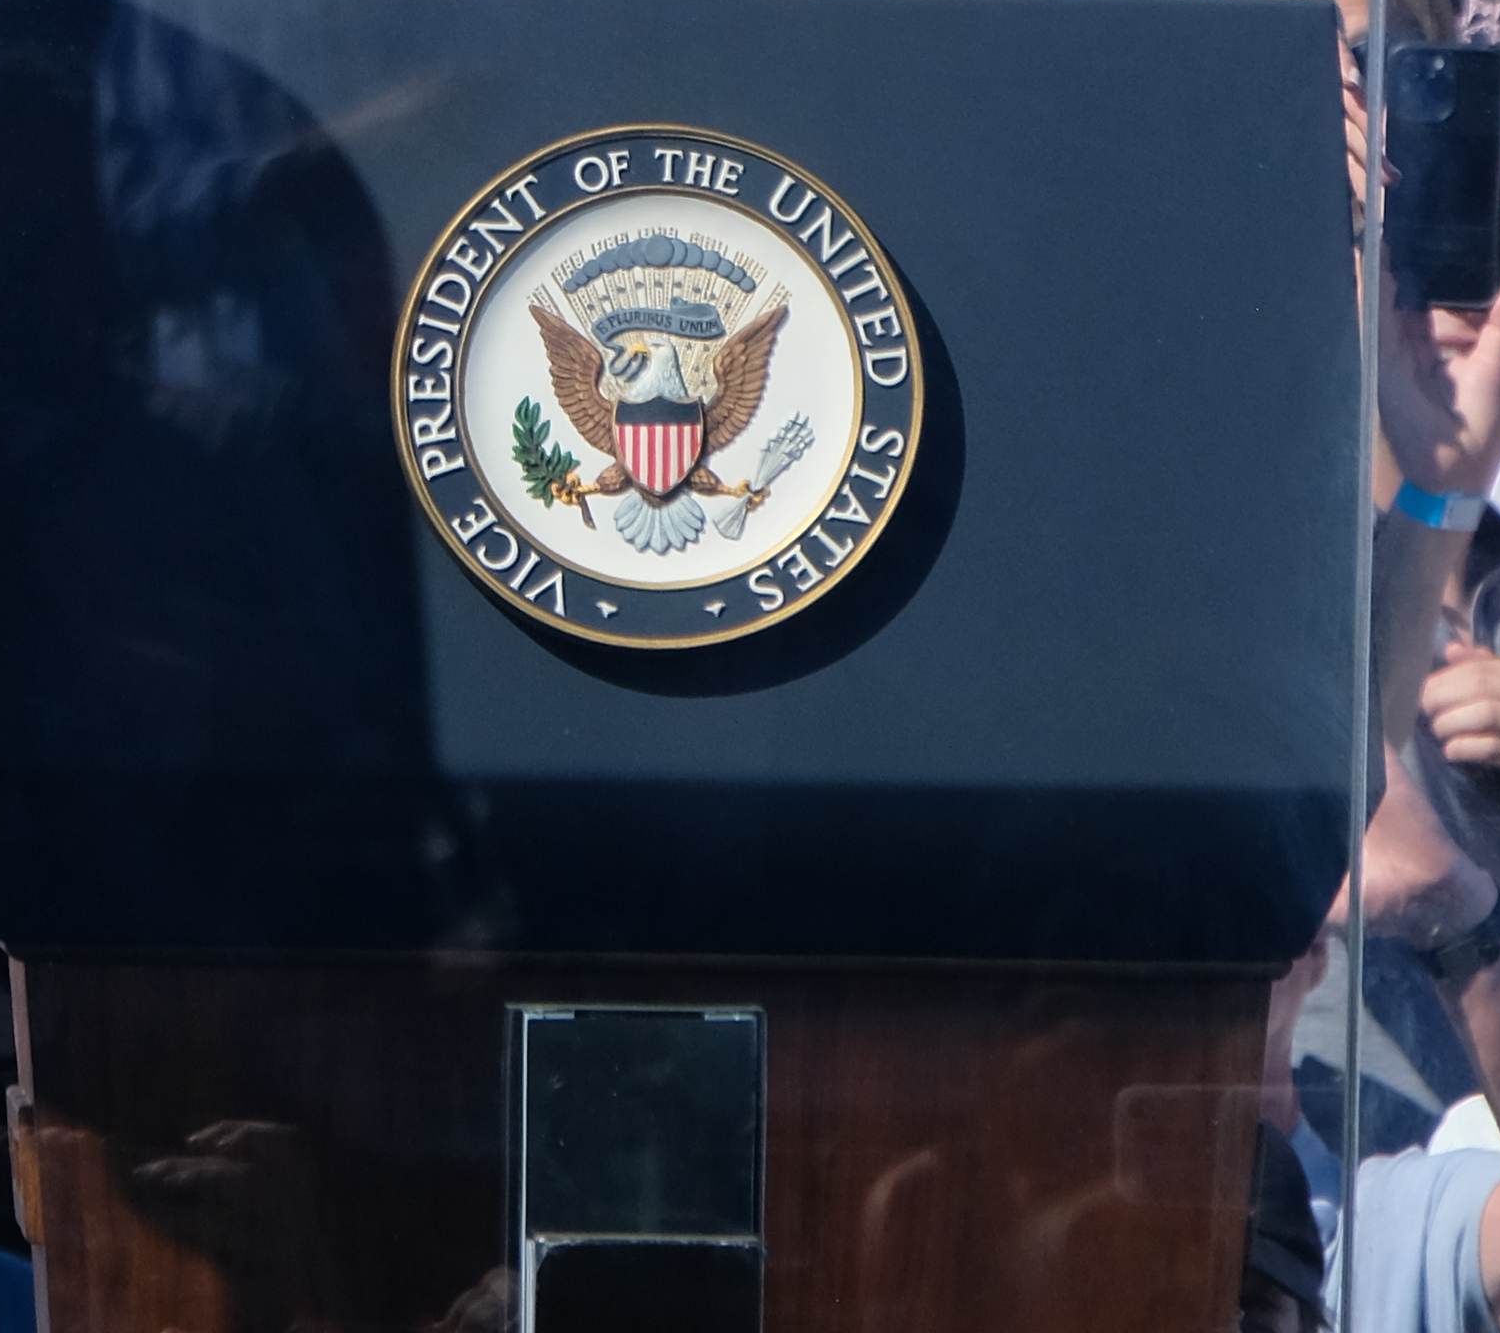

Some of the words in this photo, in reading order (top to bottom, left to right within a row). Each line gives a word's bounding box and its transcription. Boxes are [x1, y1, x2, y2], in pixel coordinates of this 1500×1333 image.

[574, 150, 632, 194] OF
[654, 148, 745, 196] THE
[409, 174, 548, 482] PRESIDENT
[680, 319, 720, 333] UNUM
[768, 175, 910, 388] UNITED
[451, 498, 568, 617] VICE
[748, 424, 904, 613] STATES
